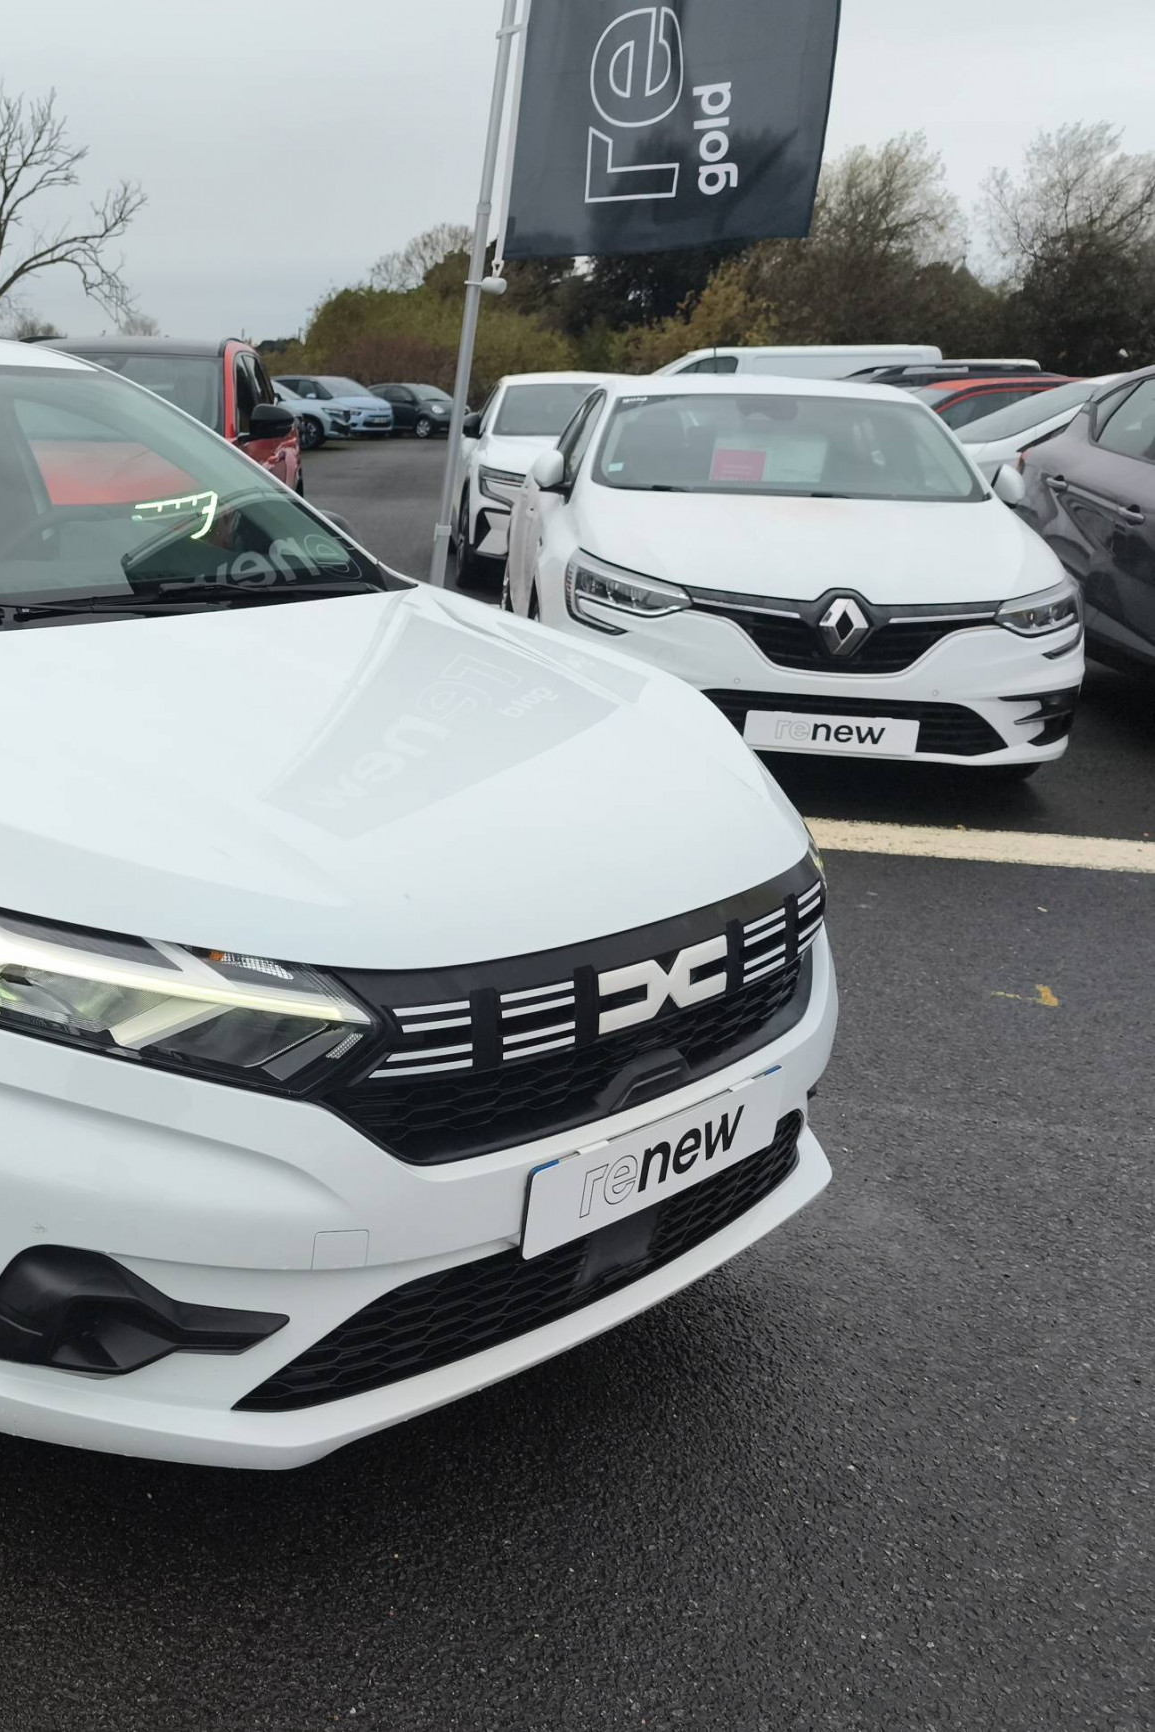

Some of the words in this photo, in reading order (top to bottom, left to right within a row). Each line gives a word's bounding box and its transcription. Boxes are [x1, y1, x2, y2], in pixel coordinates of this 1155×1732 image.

[583, 7, 684, 204] re
[692, 82, 738, 196] gold
[774, 719, 887, 745] renew
[578, 1104, 746, 1220] renew
